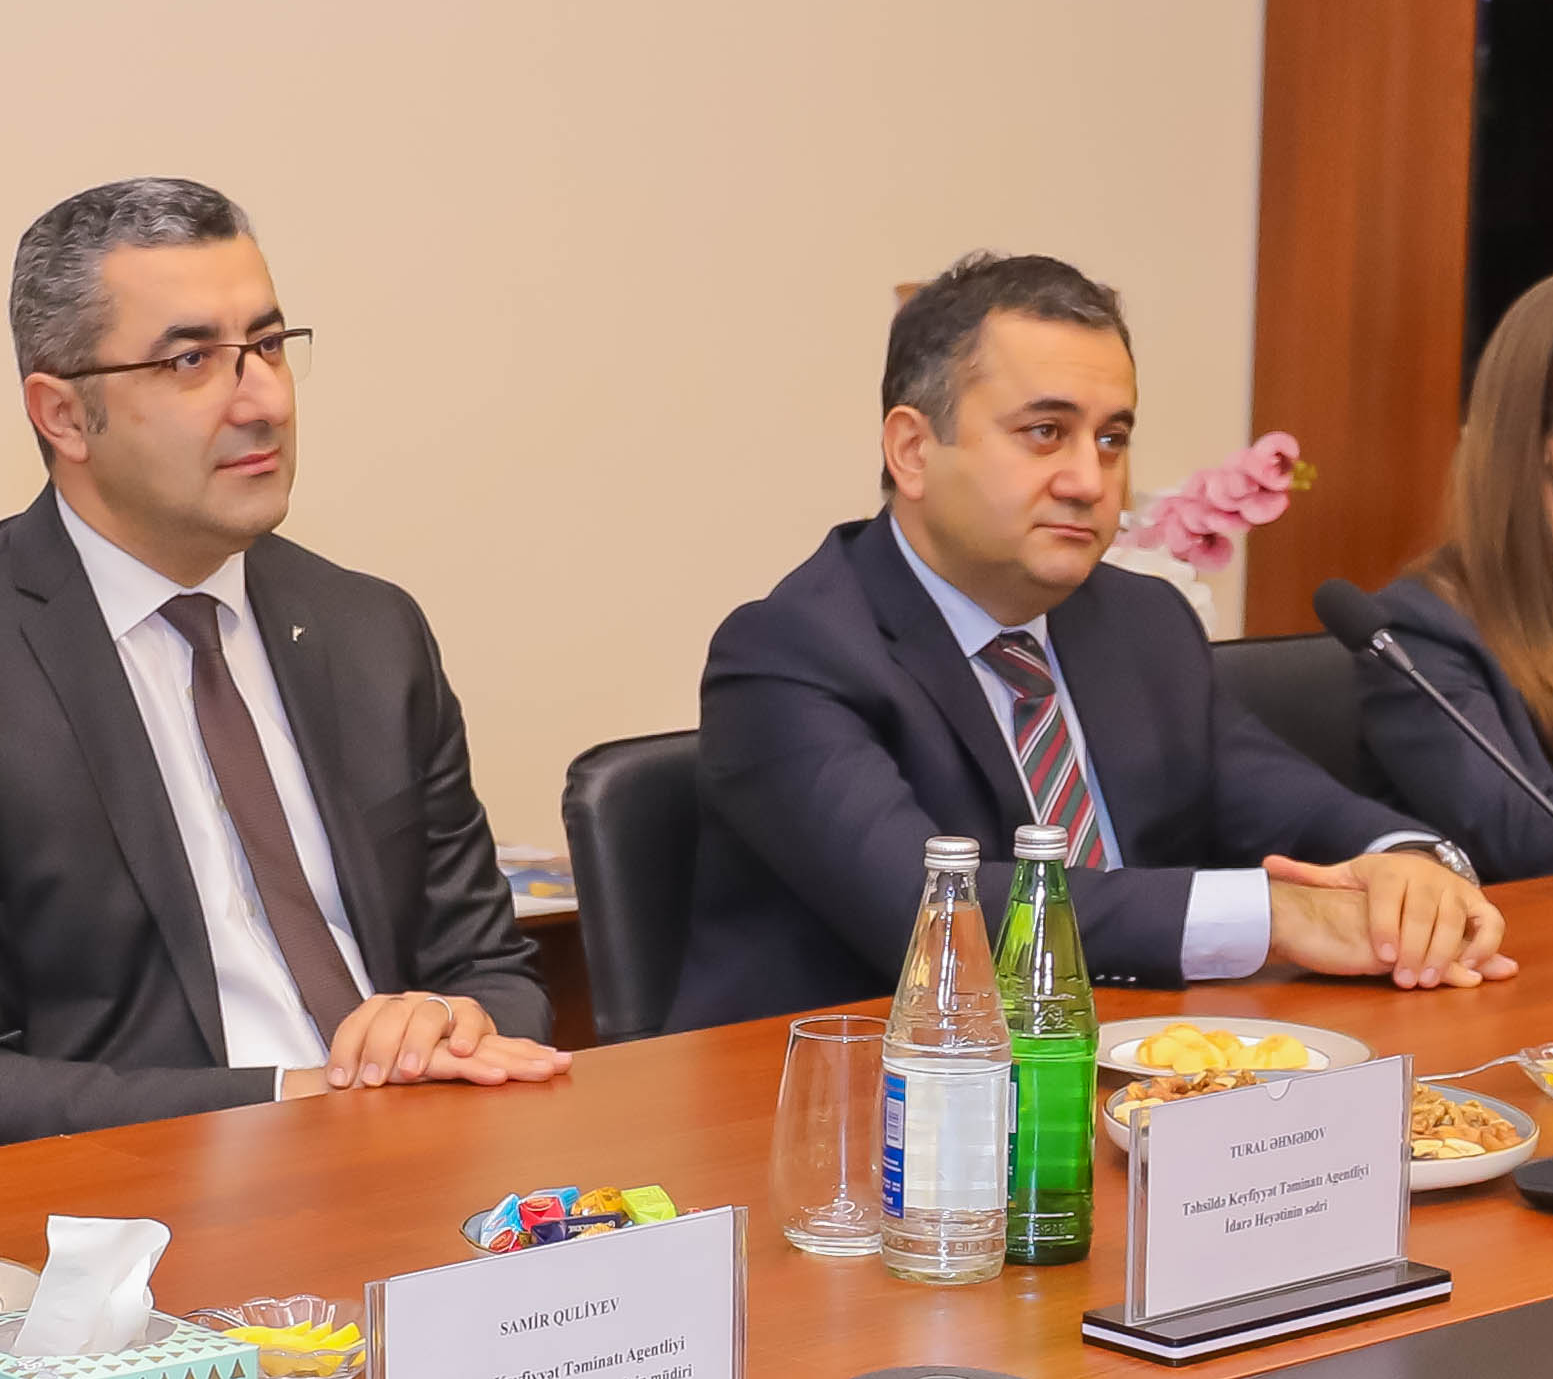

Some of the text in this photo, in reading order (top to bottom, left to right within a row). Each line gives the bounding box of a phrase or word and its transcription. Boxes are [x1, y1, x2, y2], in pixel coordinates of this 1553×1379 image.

[500, 1297, 620, 1336] SAMİR QULİYEV
[563, 1352, 623, 1377] Təminatı
[626, 1335, 685, 1364] Agentliyi
